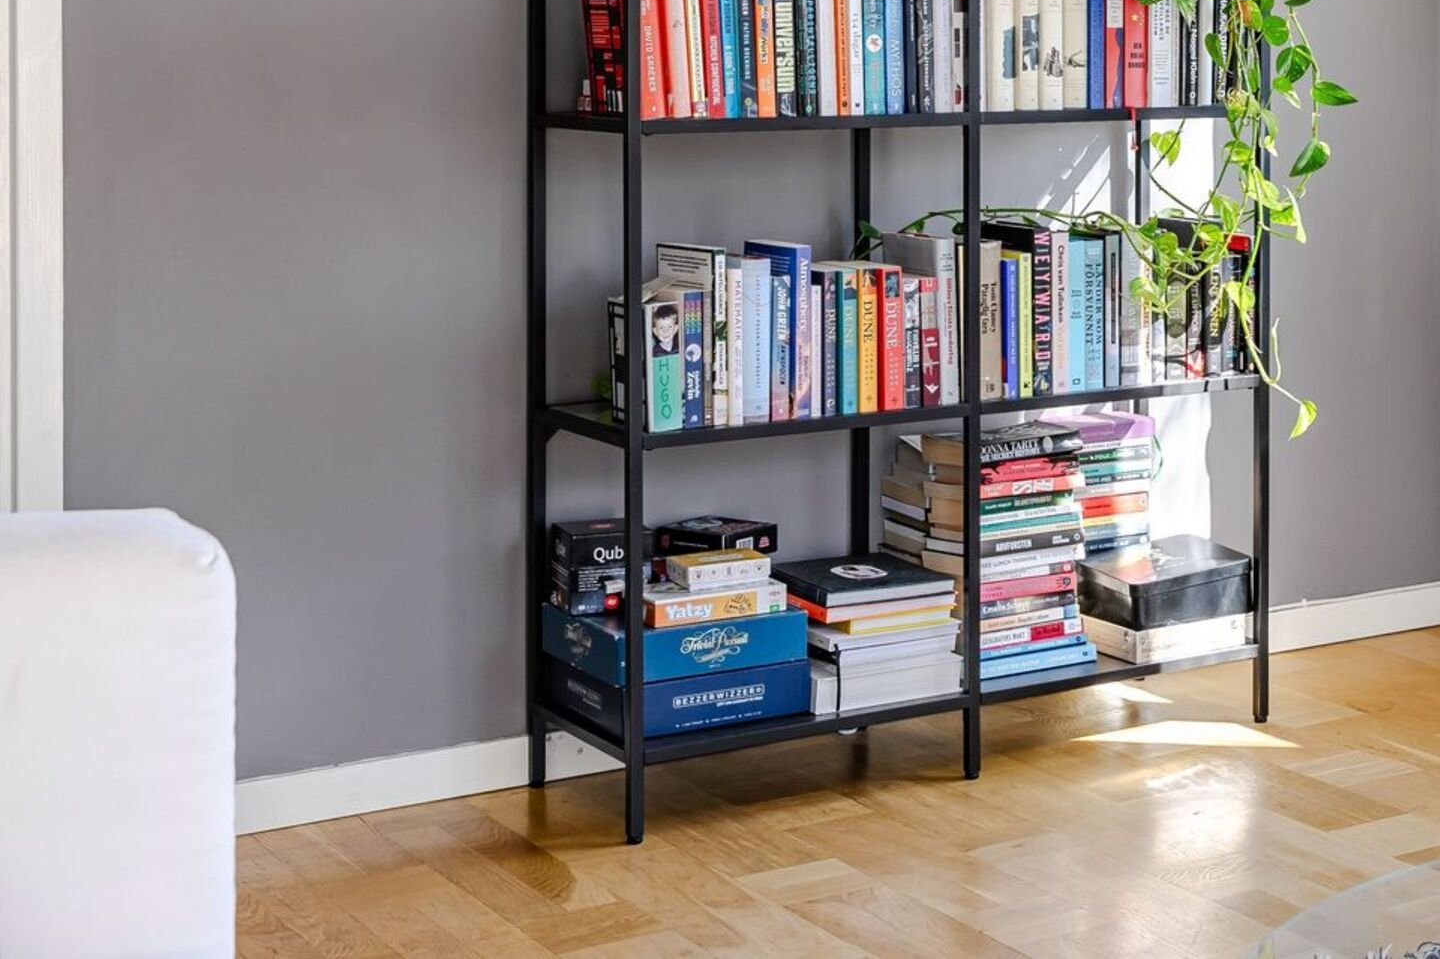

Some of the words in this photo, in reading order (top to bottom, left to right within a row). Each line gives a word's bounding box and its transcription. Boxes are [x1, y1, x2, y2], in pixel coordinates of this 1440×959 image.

[868, 13, 879, 29] Fry
[643, 25, 655, 53] DAVID
[775, 2, 796, 93] universum
[1189, 28, 1197, 60] Naomi
[890, 39, 902, 97] MYTHOS
[1189, 61, 1197, 84] Klein
[1057, 245, 1065, 268] Chris
[777, 286, 787, 310] JOHN
[797, 257, 810, 333] Atmosphere
[1057, 287, 1065, 324] Tulleken
[1085, 263, 1095, 346] FÖRSVUNNIT
[733, 280, 742, 342] MATEMATIK
[777, 311, 788, 341] GREEN
[827, 308, 836, 343] DUNE
[843, 305, 853, 345] DUNE
[862, 300, 874, 344] DUNE
[886, 301, 898, 349] DUNE
[988, 303, 997, 333] Clancy
[1094, 317, 1103, 345] SOM
[657, 359, 673, 420] HUGO
[685, 371, 695, 401] Zevin
[980, 452, 989, 462] HE
[1010, 438, 1040, 451] TARTT
[593, 545, 625, 563] Qub
[992, 559, 1011, 568] LUNCH
[666, 603, 713, 619] Yatzy
[680, 629, 718, 654] Trivial
